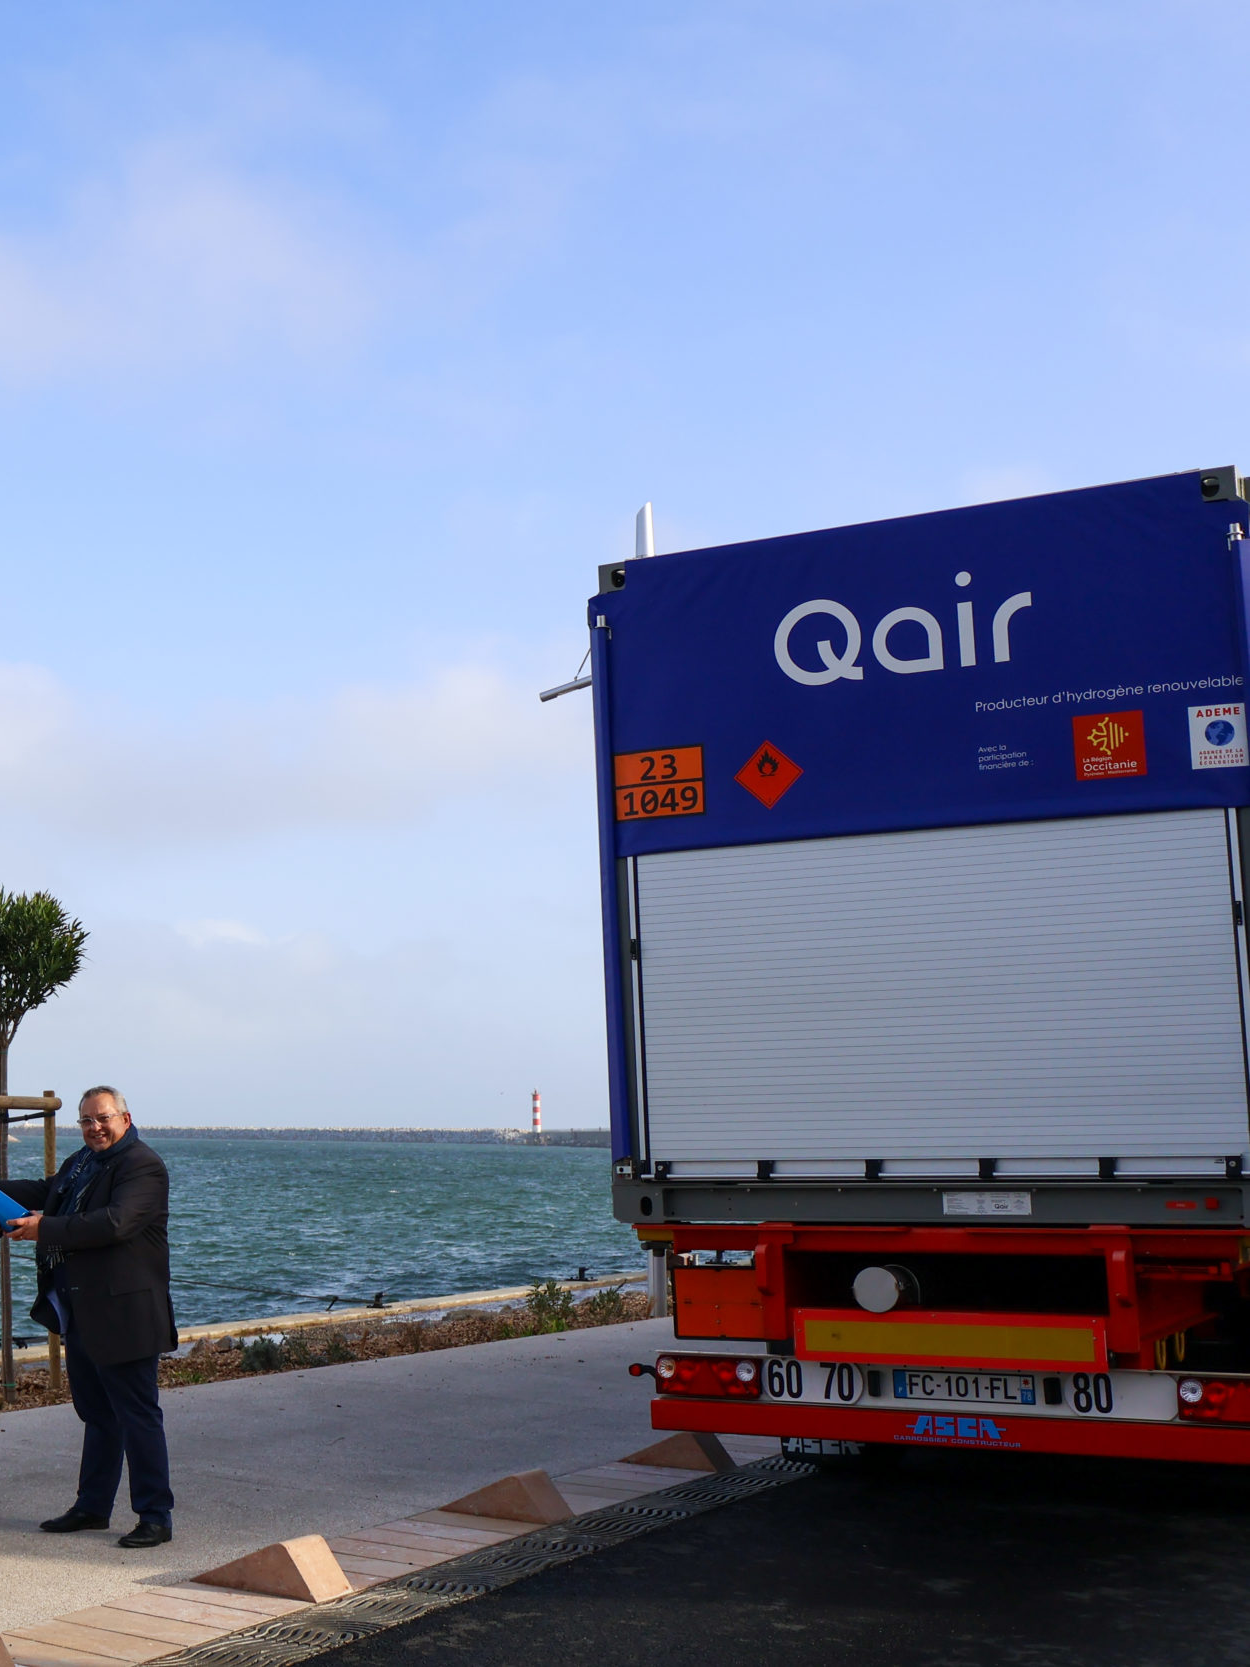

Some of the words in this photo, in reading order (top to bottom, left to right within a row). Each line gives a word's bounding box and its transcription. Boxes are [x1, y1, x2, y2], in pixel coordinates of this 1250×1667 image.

[773, 571, 1032, 686] Qair
[975, 695, 1049, 712] Producteur
[1052, 684, 1144, 703] d'hydrogène
[1147, 675, 1244, 693] renouvelable
[1196, 706, 1241, 718] ADEME
[978, 745, 998, 753] Avec
[978, 751, 1027, 763] participation
[640, 754, 678, 782] 23
[1083, 759, 1137, 772] Occitanie
[623, 786, 699, 817] 1049
[768, 1359, 802, 1398] 60
[819, 1362, 854, 1401] 70
[907, 1373, 1018, 1400] FC-101-FL
[1073, 1372, 1113, 1413] 80
[893, 1434, 948, 1443] CARROSSIER
[950, 1437, 1022, 1448] CONSTRUCTEUR
